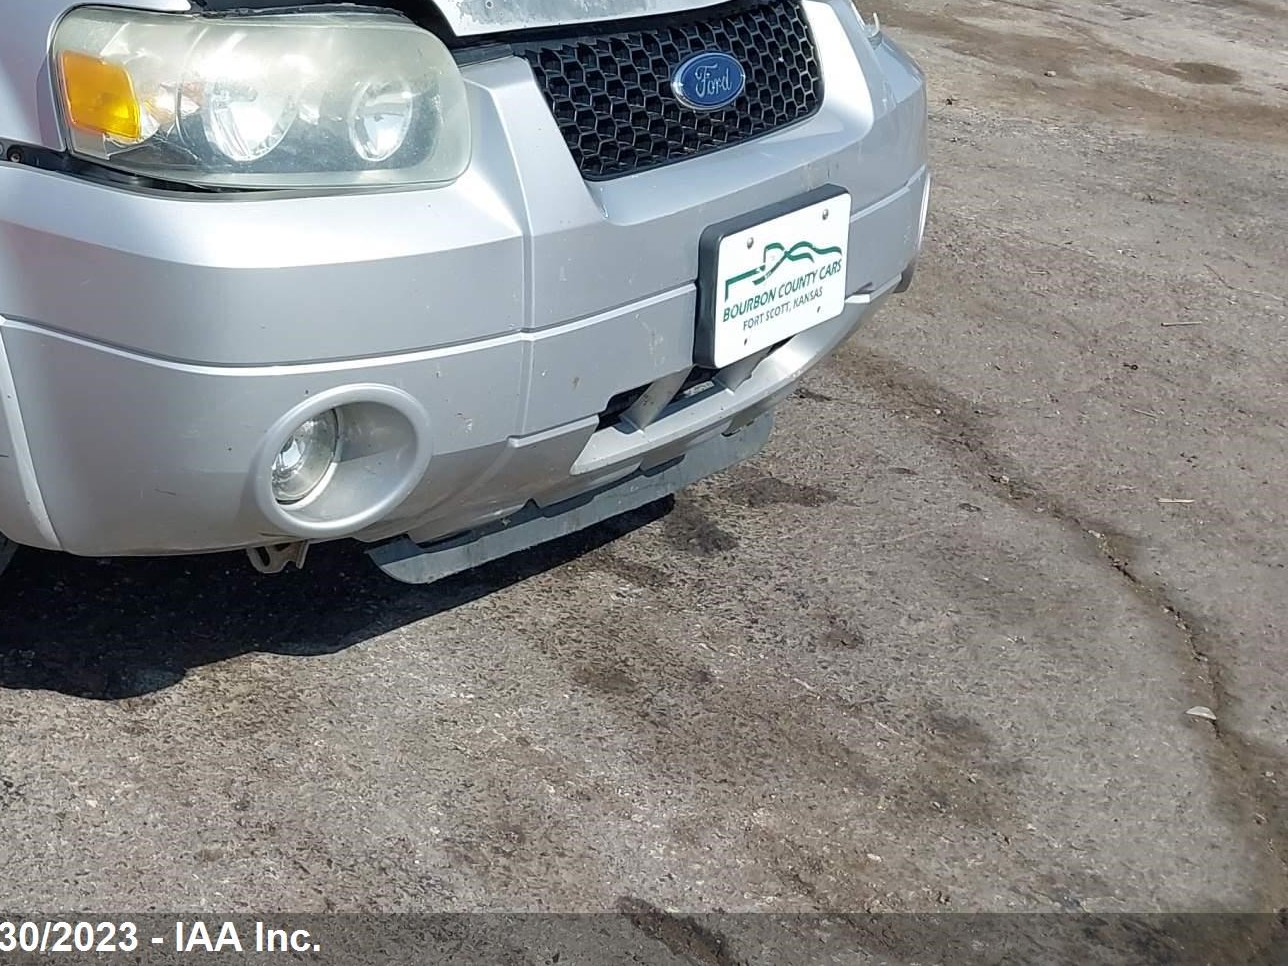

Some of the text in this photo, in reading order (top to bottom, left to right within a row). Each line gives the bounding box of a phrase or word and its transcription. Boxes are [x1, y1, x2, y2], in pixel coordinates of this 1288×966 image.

[694, 63, 733, 98] Ford
[722, 258, 842, 322] BOURBON COUNTY CARS
[743, 286, 823, 330] FORT SCOTT, KANSAS
